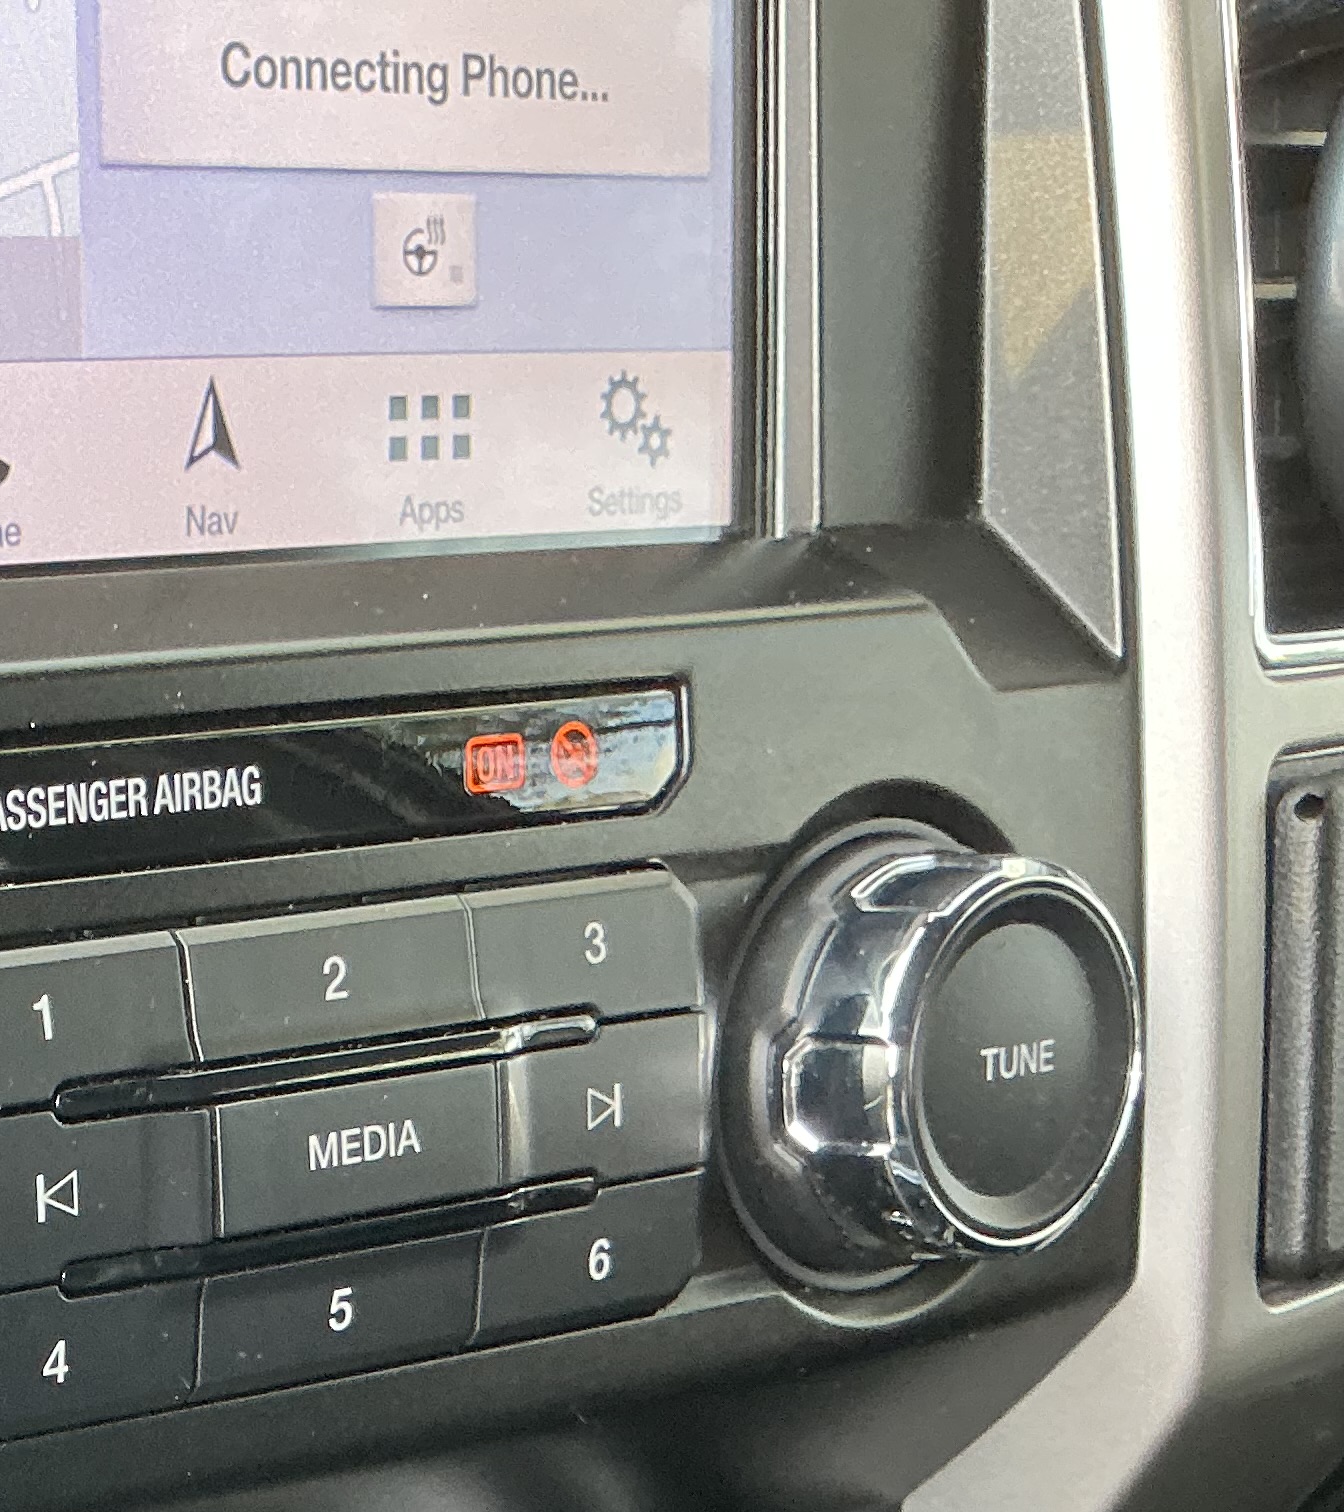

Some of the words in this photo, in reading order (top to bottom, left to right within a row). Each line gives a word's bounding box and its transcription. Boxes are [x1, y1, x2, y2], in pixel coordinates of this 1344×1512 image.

[220, 41, 449, 106] Connecting
[461, 52, 610, 103] Phone...
[184, 505, 239, 537] Nav
[399, 495, 465, 530] Apps
[587, 485, 683, 518] Settings
[476, 745, 515, 783] ON
[153, 765, 263, 815] AIRBAG
[582, 921, 609, 965] 3
[321, 955, 349, 1001] 2
[31, 993, 54, 1041] 1
[980, 1039, 1055, 1082] TUNE
[307, 1119, 422, 1171] MEDIA
[587, 1237, 611, 1281] 6
[327, 1286, 354, 1332] 5
[41, 1339, 69, 1384] 4
